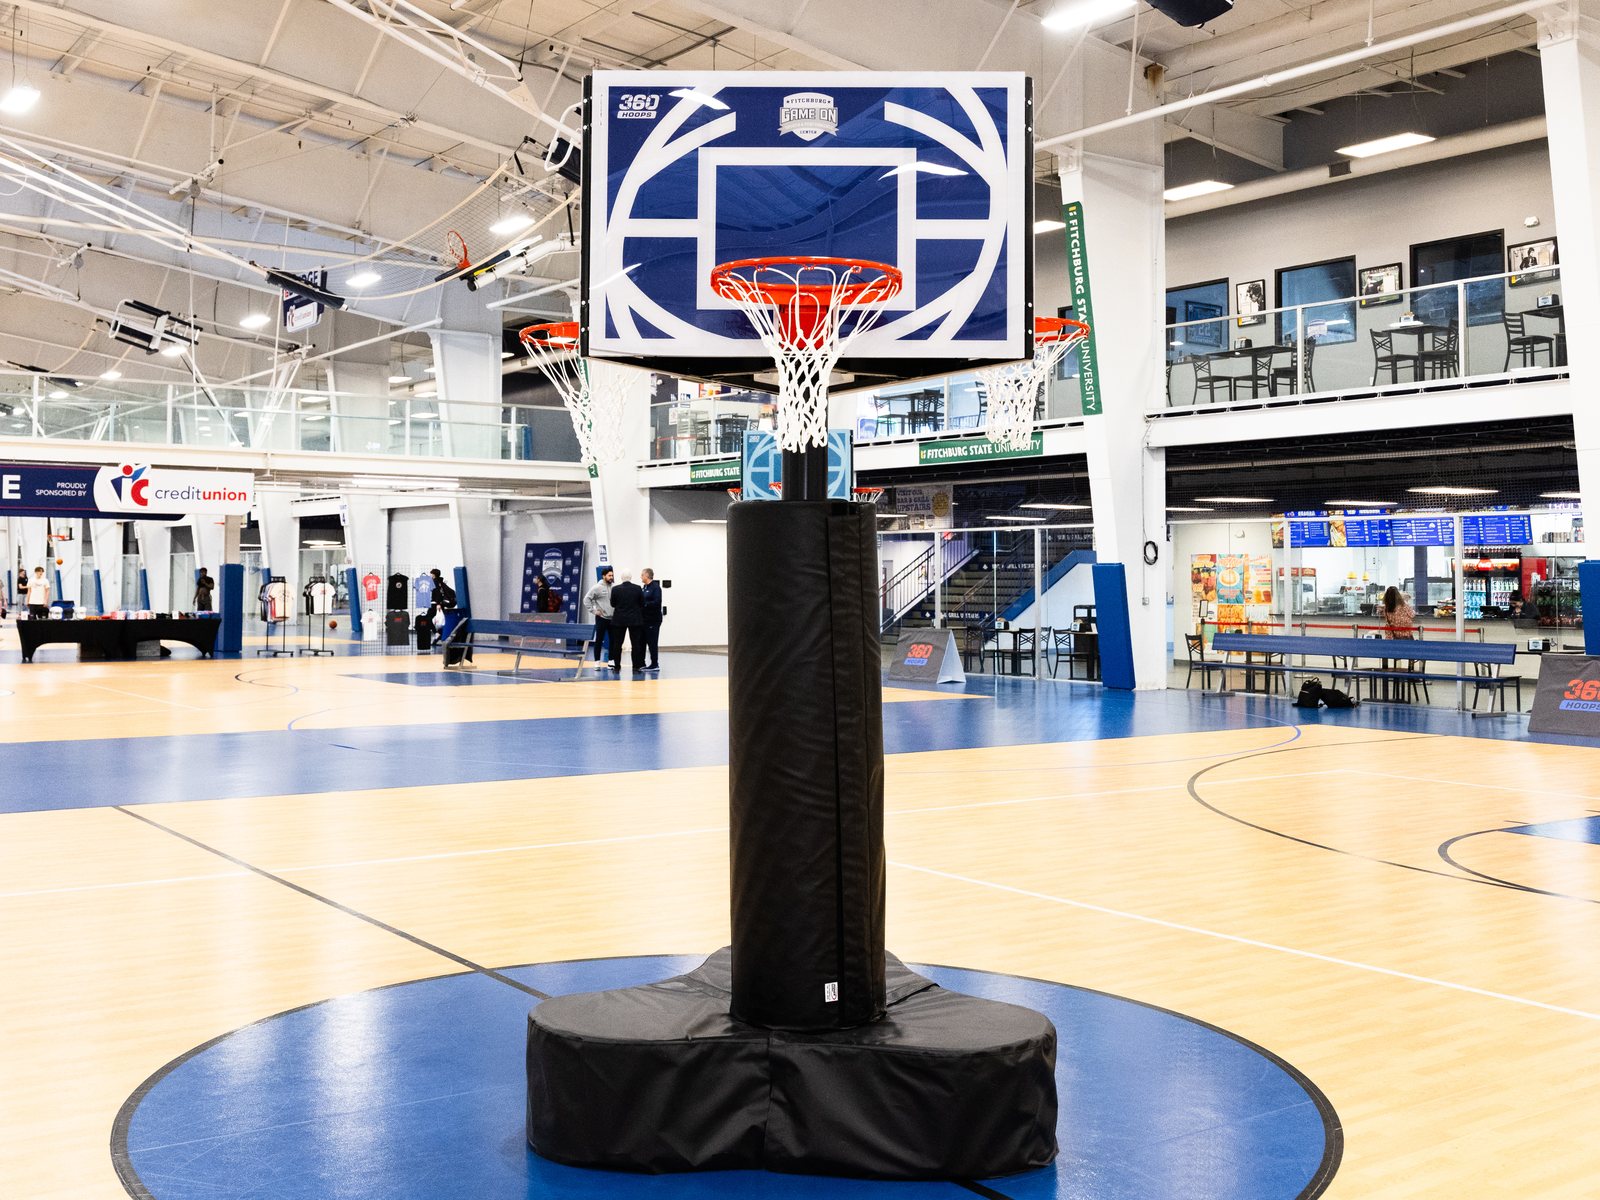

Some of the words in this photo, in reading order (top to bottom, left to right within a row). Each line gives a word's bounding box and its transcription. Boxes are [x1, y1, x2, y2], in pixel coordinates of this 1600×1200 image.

[619, 94, 660, 110] 360
[781, 107, 817, 124] GAME
[819, 107, 837, 125] ON
[1069, 219, 1085, 295] FITCHBURG
[1081, 340, 1096, 411] UNIVERSITY
[926, 446, 968, 459] FITCHBURG
[969, 444, 992, 455] STATE
[695, 468, 723, 479] FITCHBURG
[723, 466, 740, 477] STATE
[2, 474, 21, 500] E
[35, 489, 76, 497] SPONSORED
[897, 503, 931, 512] UPSTAIRS
[907, 643, 933, 659] 360
[1563, 679, 1600, 701] 36
